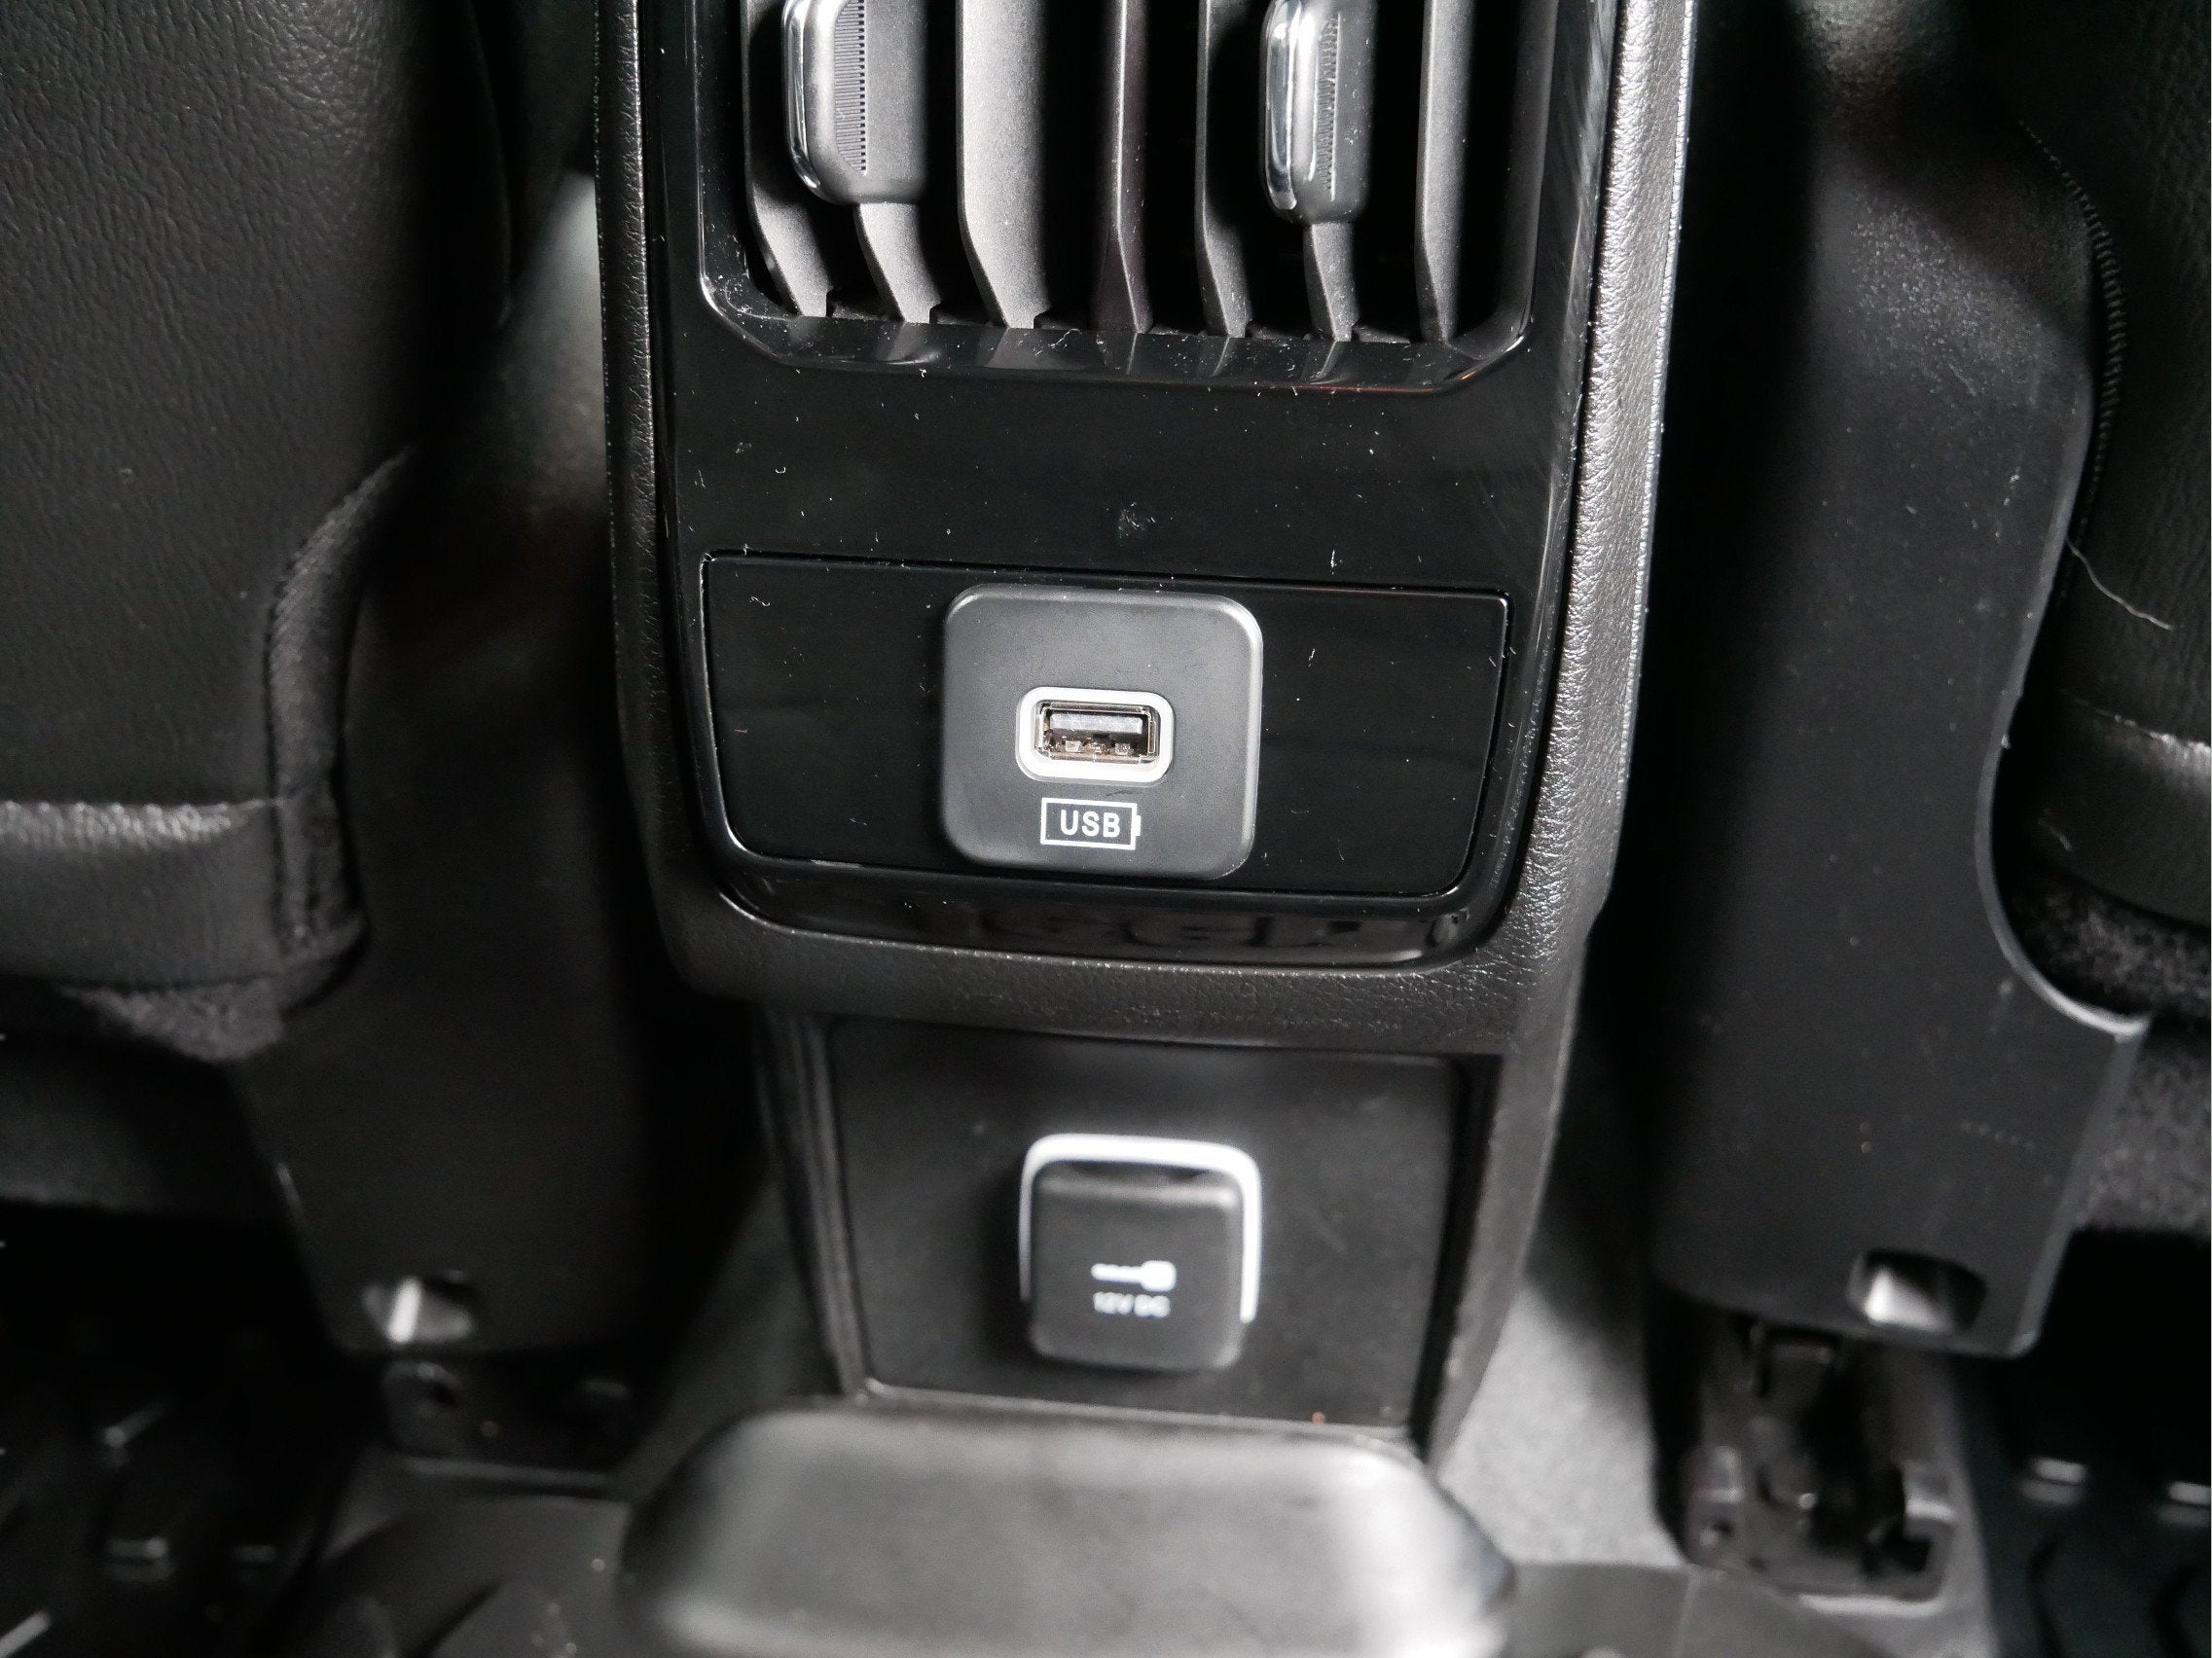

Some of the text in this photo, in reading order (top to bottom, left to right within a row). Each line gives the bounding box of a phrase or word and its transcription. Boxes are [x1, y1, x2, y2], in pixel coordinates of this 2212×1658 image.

[1061, 809, 1121, 838] USB
[1093, 1291, 1171, 1317] 12V DC
